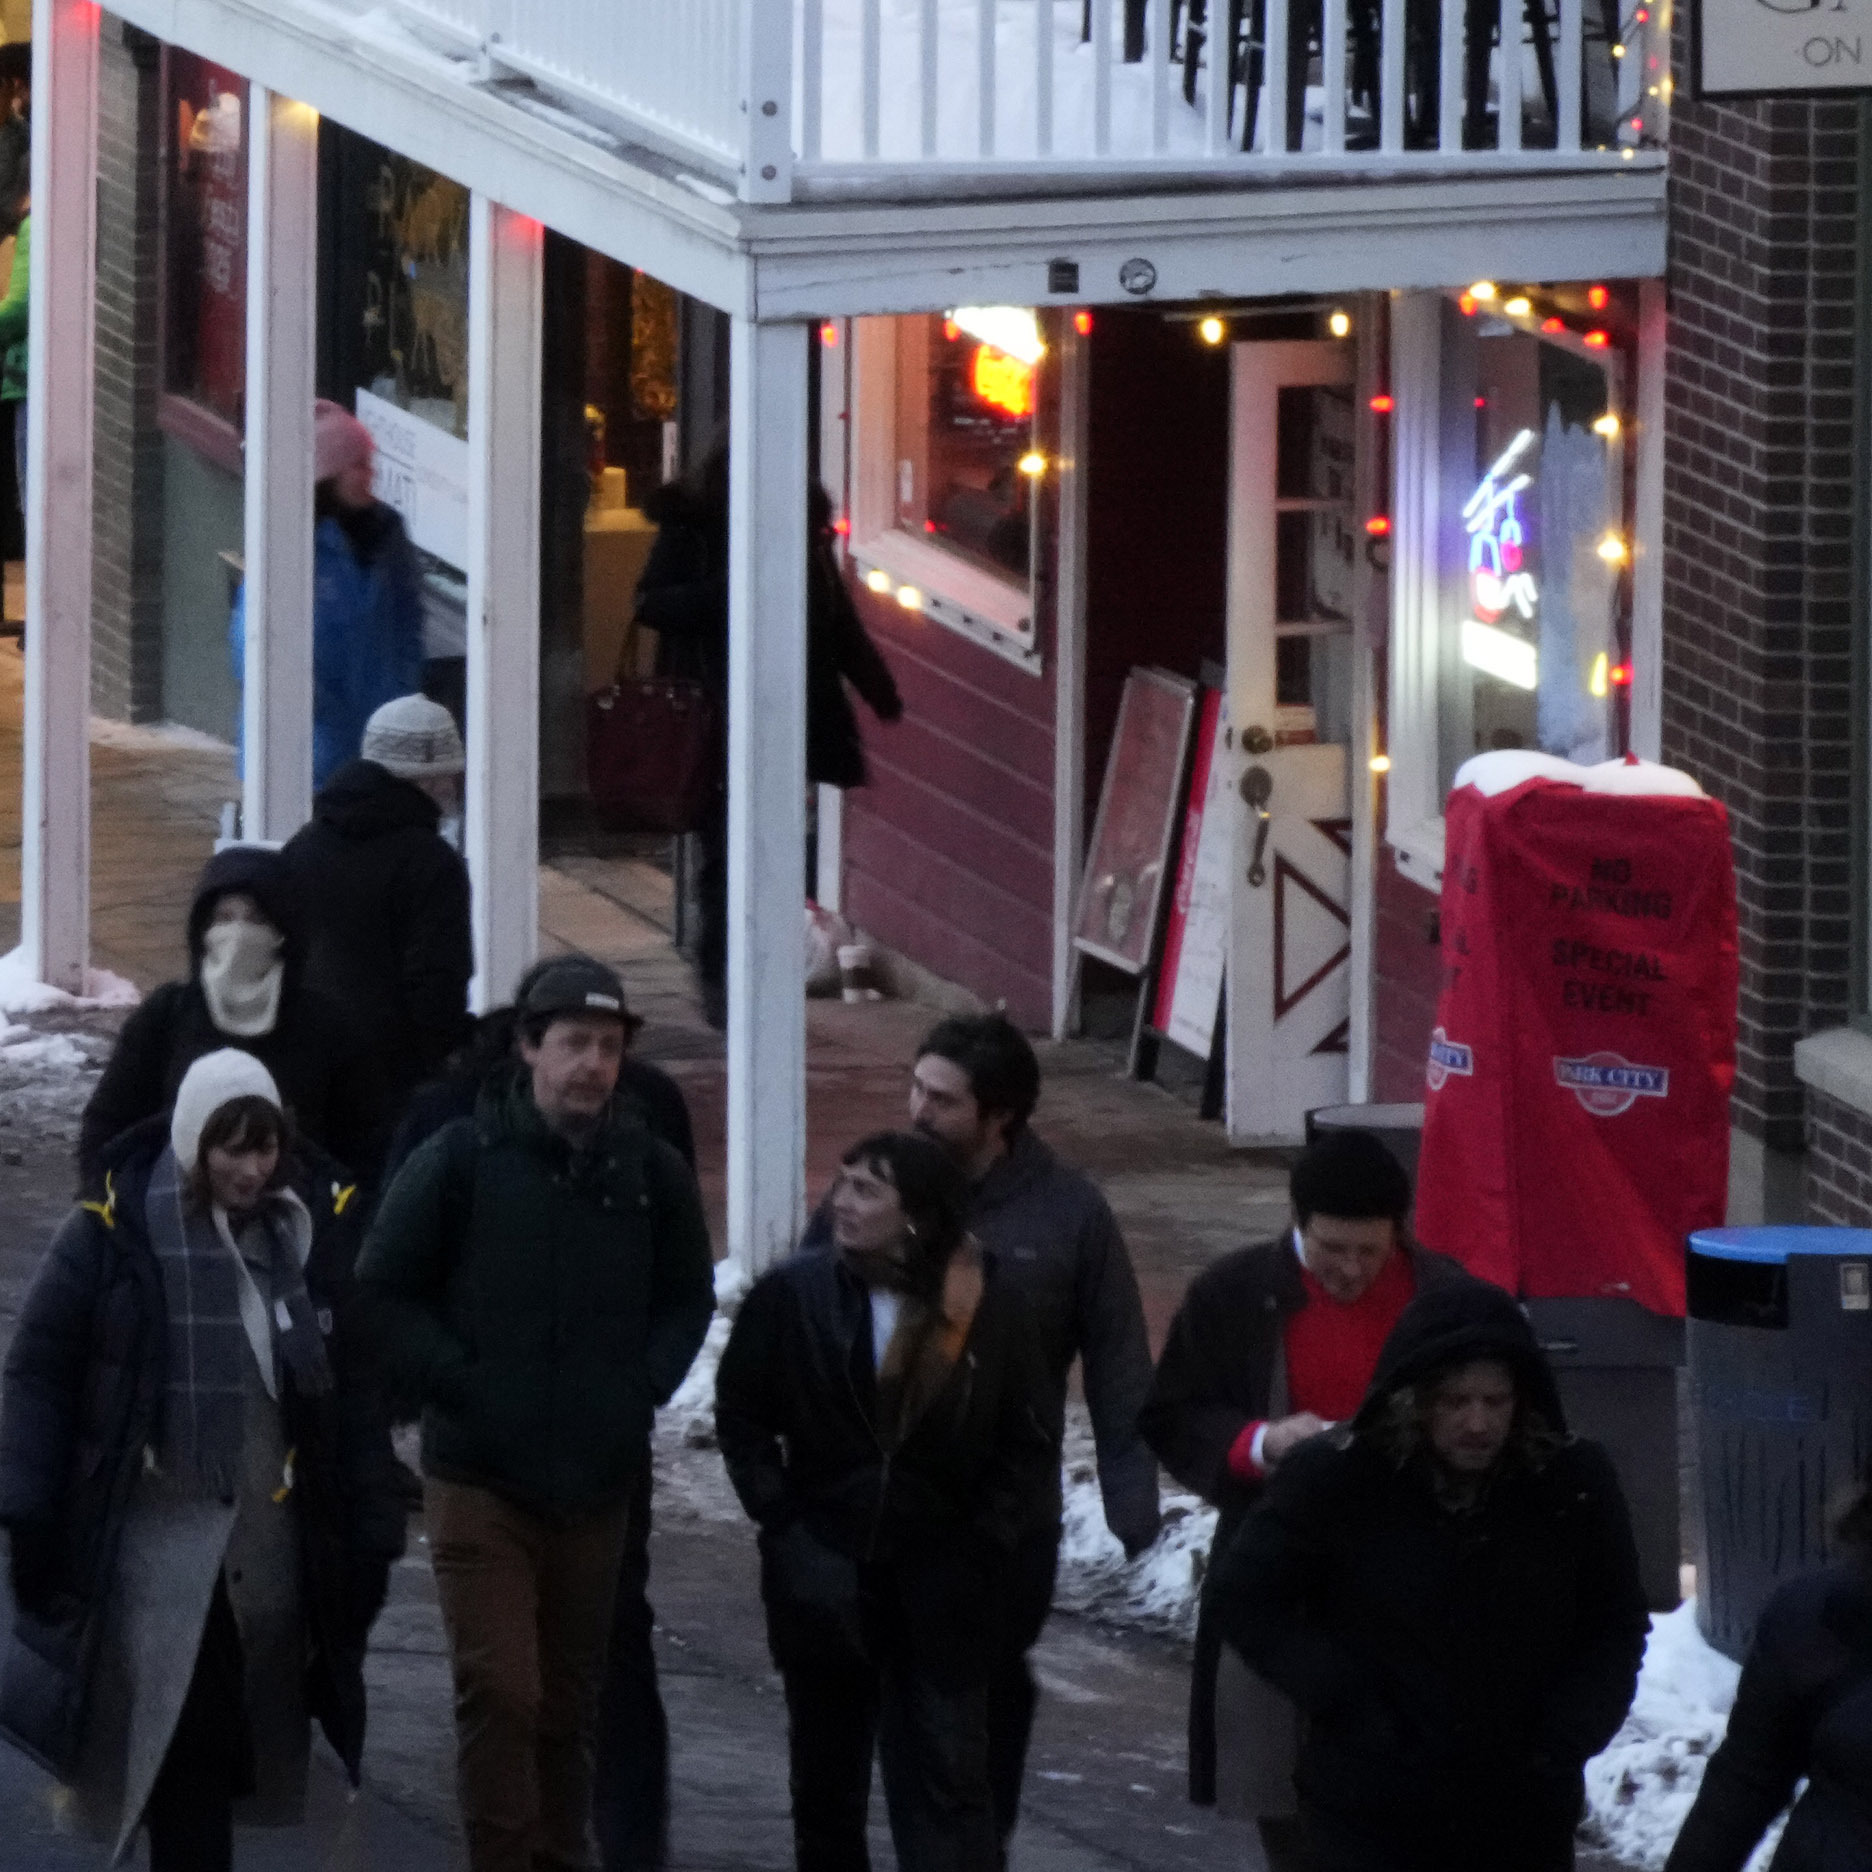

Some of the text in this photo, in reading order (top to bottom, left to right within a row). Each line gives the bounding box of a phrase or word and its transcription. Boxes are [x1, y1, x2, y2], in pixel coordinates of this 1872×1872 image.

[1803, 35, 1861, 68] ON
[1591, 857, 1632, 884] NO
[1551, 881, 1672, 920] PARKING
[1552, 937, 1668, 982] SPECIAL
[1562, 978, 1654, 1017] EVENT
